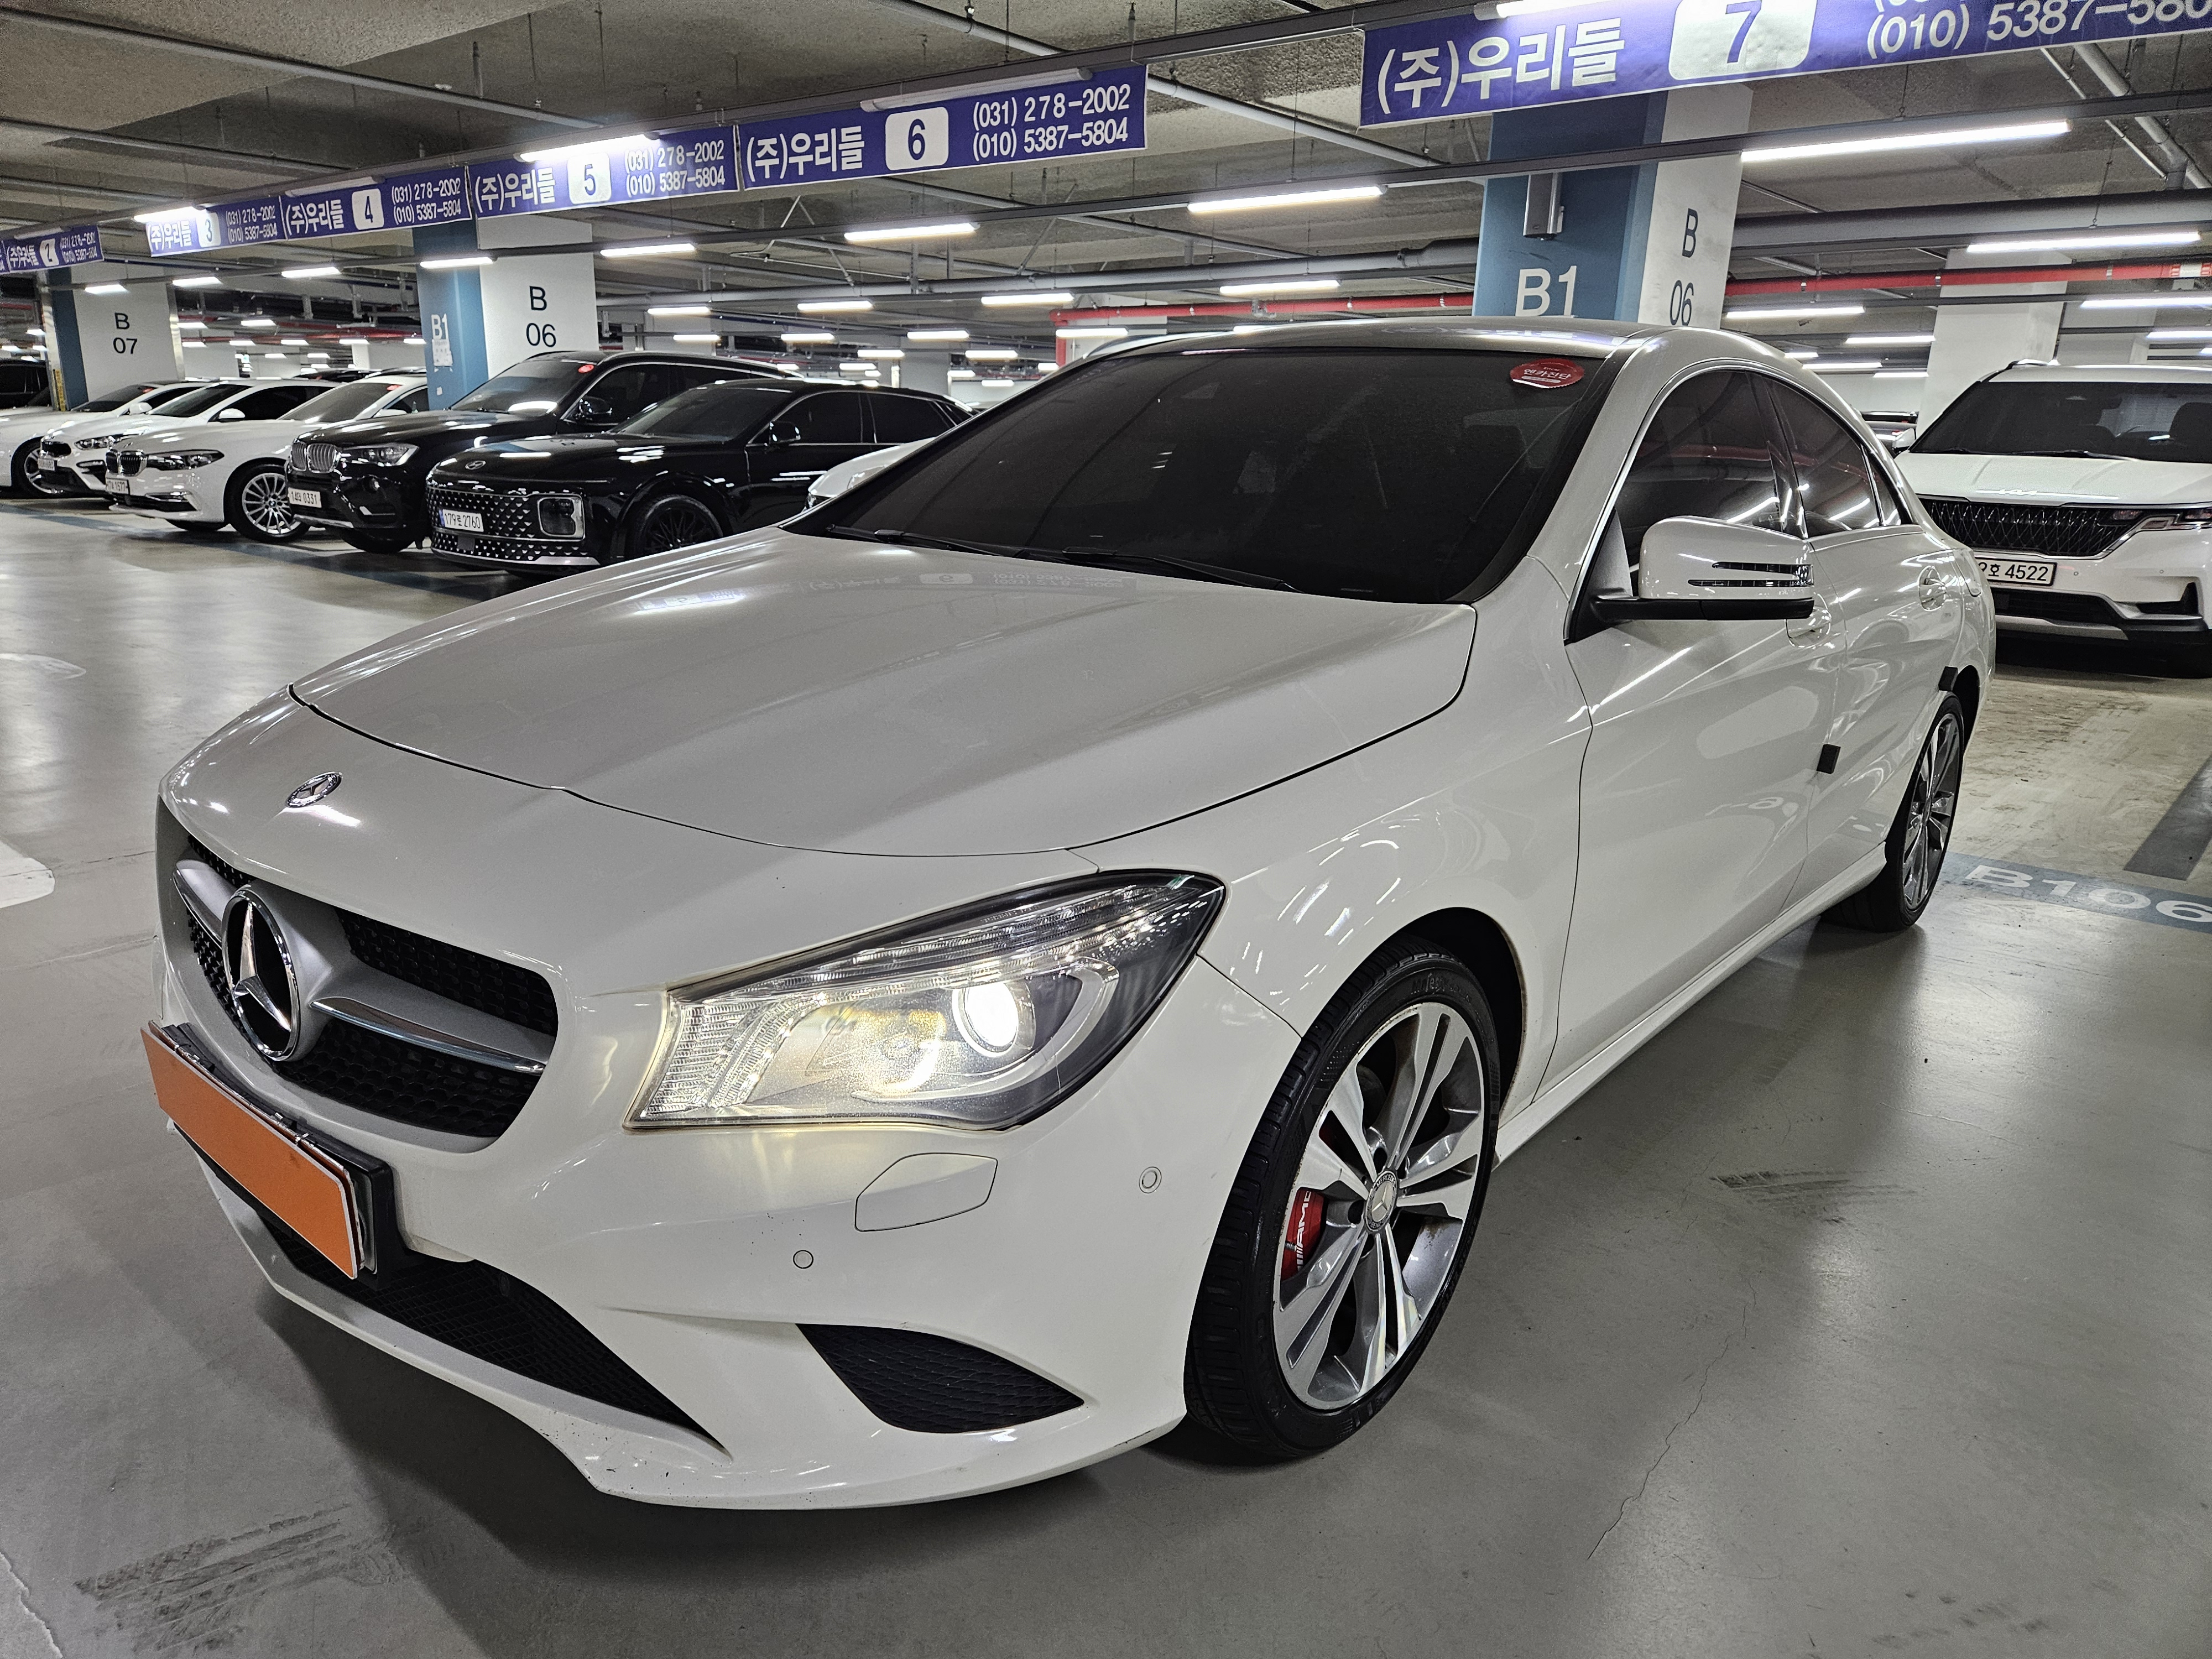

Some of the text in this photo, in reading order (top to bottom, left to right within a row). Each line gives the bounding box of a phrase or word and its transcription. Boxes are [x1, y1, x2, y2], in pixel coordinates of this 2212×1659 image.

[1725, 0, 1762, 65] 7
[1867, 3, 1970, 59] (010)
[1378, 17, 1625, 114] (주)우리들
[973, 83, 1130, 131] (031) 278-2002
[747, 126, 865, 182] (주)우리들
[907, 118, 926, 160] 6
[973, 116, 1129, 161] (010) 5387-5804
[624, 139, 724, 174] (031) 278-2002
[392, 177, 461, 205] (031) 278-2002
[474, 166, 556, 213] (주)우리들
[583, 164, 597, 196] 5
[625, 165, 726, 197] (010) 5387-5804
[226, 208, 241, 227] (031)
[285, 199, 345, 236] (주)우리들
[364, 195, 374, 223] 4
[393, 198, 462, 225] (010) 5387-5804
[147, 220, 192, 252] (주)우리들
[205, 218, 213, 242] 3
[227, 226, 244, 244] (010)
[1681, 208, 1699, 258] B
[45, 243, 53, 262] 2
[529, 285, 547, 311] B
[1515, 265, 1577, 317] B1
[1669, 279, 1694, 326] 06
[114, 312, 130, 330] B
[431, 313, 449, 340] B1
[526, 322, 556, 347] 06
[113, 337, 138, 354] 07
[1524, 369, 1572, 380] 엔카진단
[302, 492, 317, 505] 0331
[462, 514, 481, 529] 2760
[2005, 564, 2049, 581] 4522
[1965, 864, 2212, 922] B106
